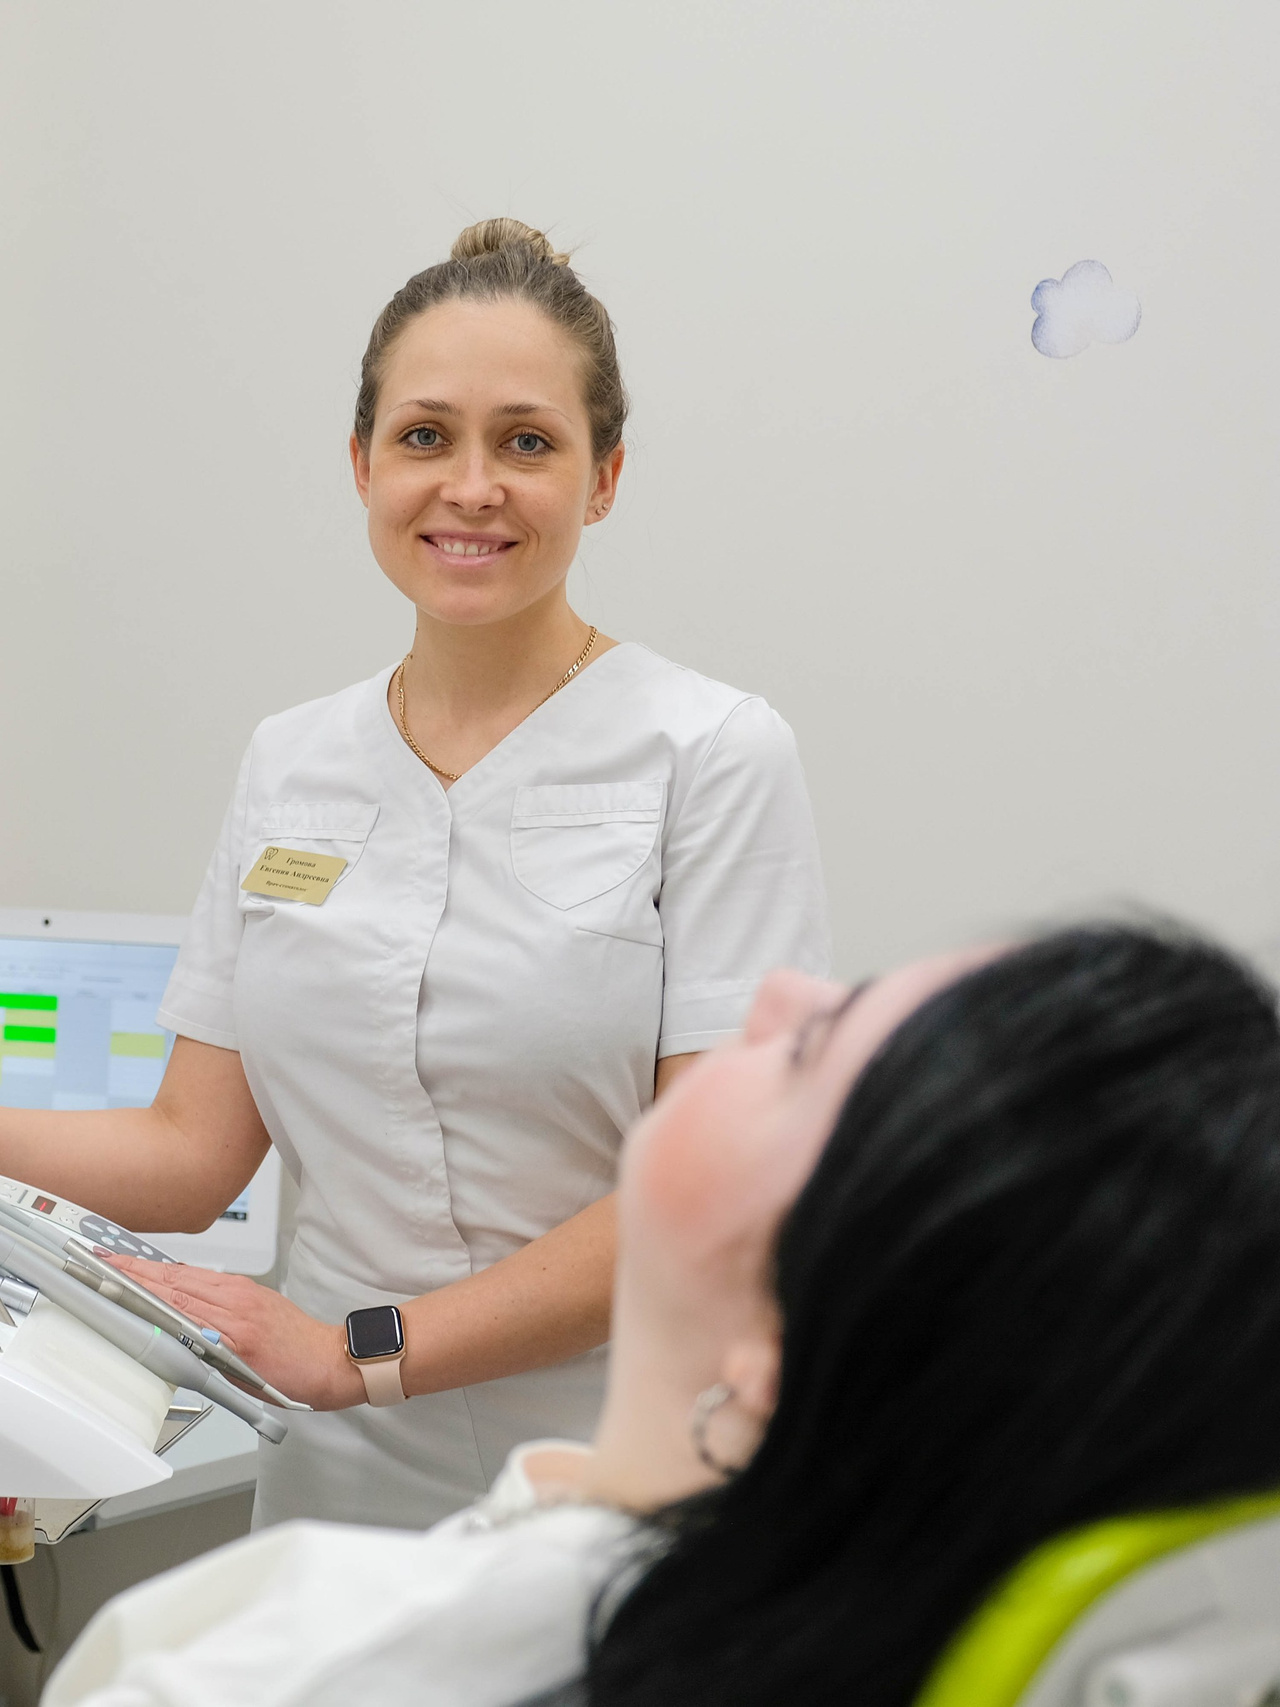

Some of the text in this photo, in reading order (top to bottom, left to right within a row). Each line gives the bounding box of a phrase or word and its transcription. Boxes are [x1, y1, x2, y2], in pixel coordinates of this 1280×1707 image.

[286, 857, 316, 868] Громова
[260, 864, 330, 883] Евгения Андреевна
